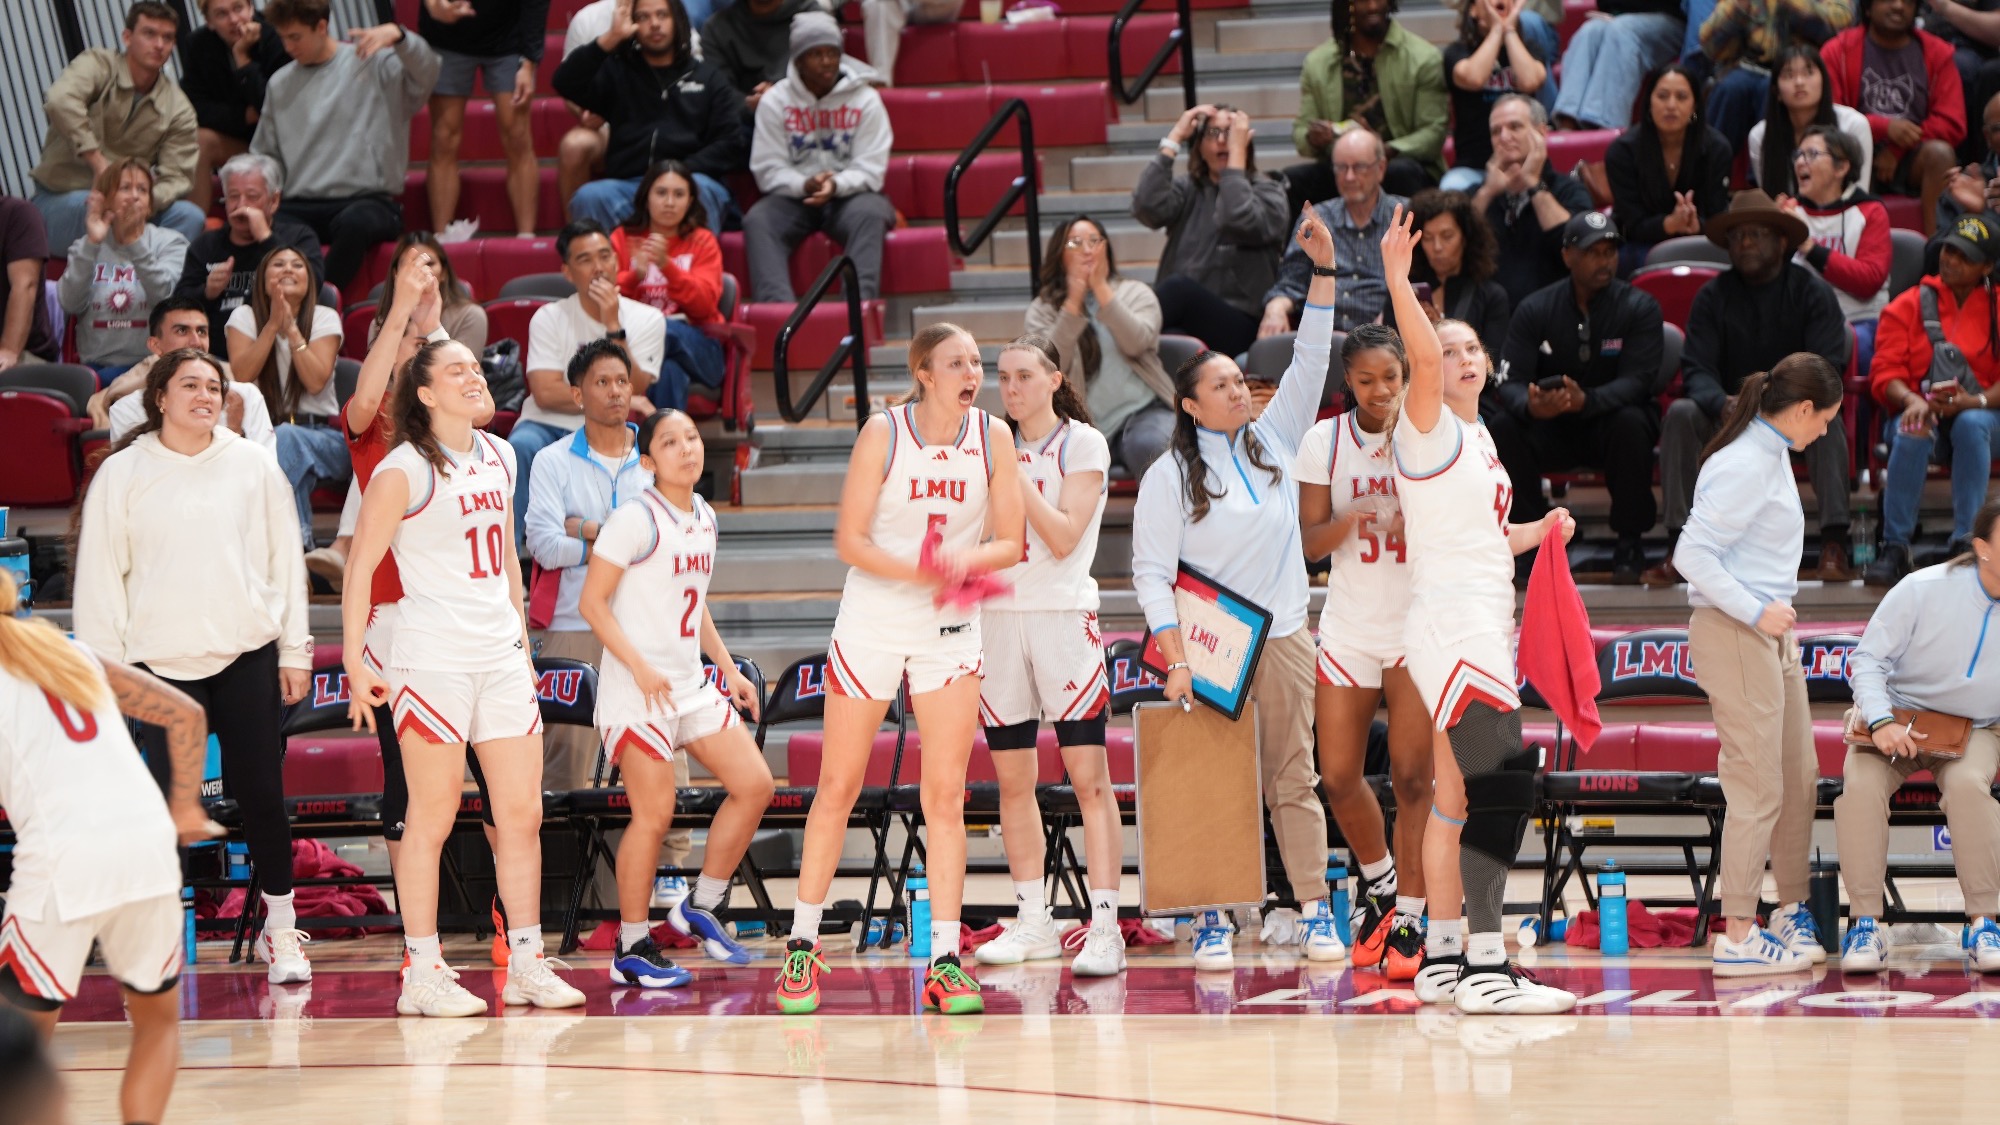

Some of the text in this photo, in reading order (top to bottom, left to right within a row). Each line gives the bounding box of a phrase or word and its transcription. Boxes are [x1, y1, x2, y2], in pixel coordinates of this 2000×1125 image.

[93, 262, 137, 284] LM
[106, 320, 132, 328] LIONS
[908, 477, 968, 503] LMU
[458, 490, 505, 519] LMU
[465, 523, 503, 579] 10
[672, 552, 712, 578] LMU
[680, 586, 699, 637] 2
[535, 668, 584, 706] MU
[1579, 774, 1639, 792] LIONS
[296, 800, 347, 815] LIONS
[606, 794, 630, 808] LIO
[770, 794, 803, 808] ONS
[1895, 791, 1943, 805] LION
